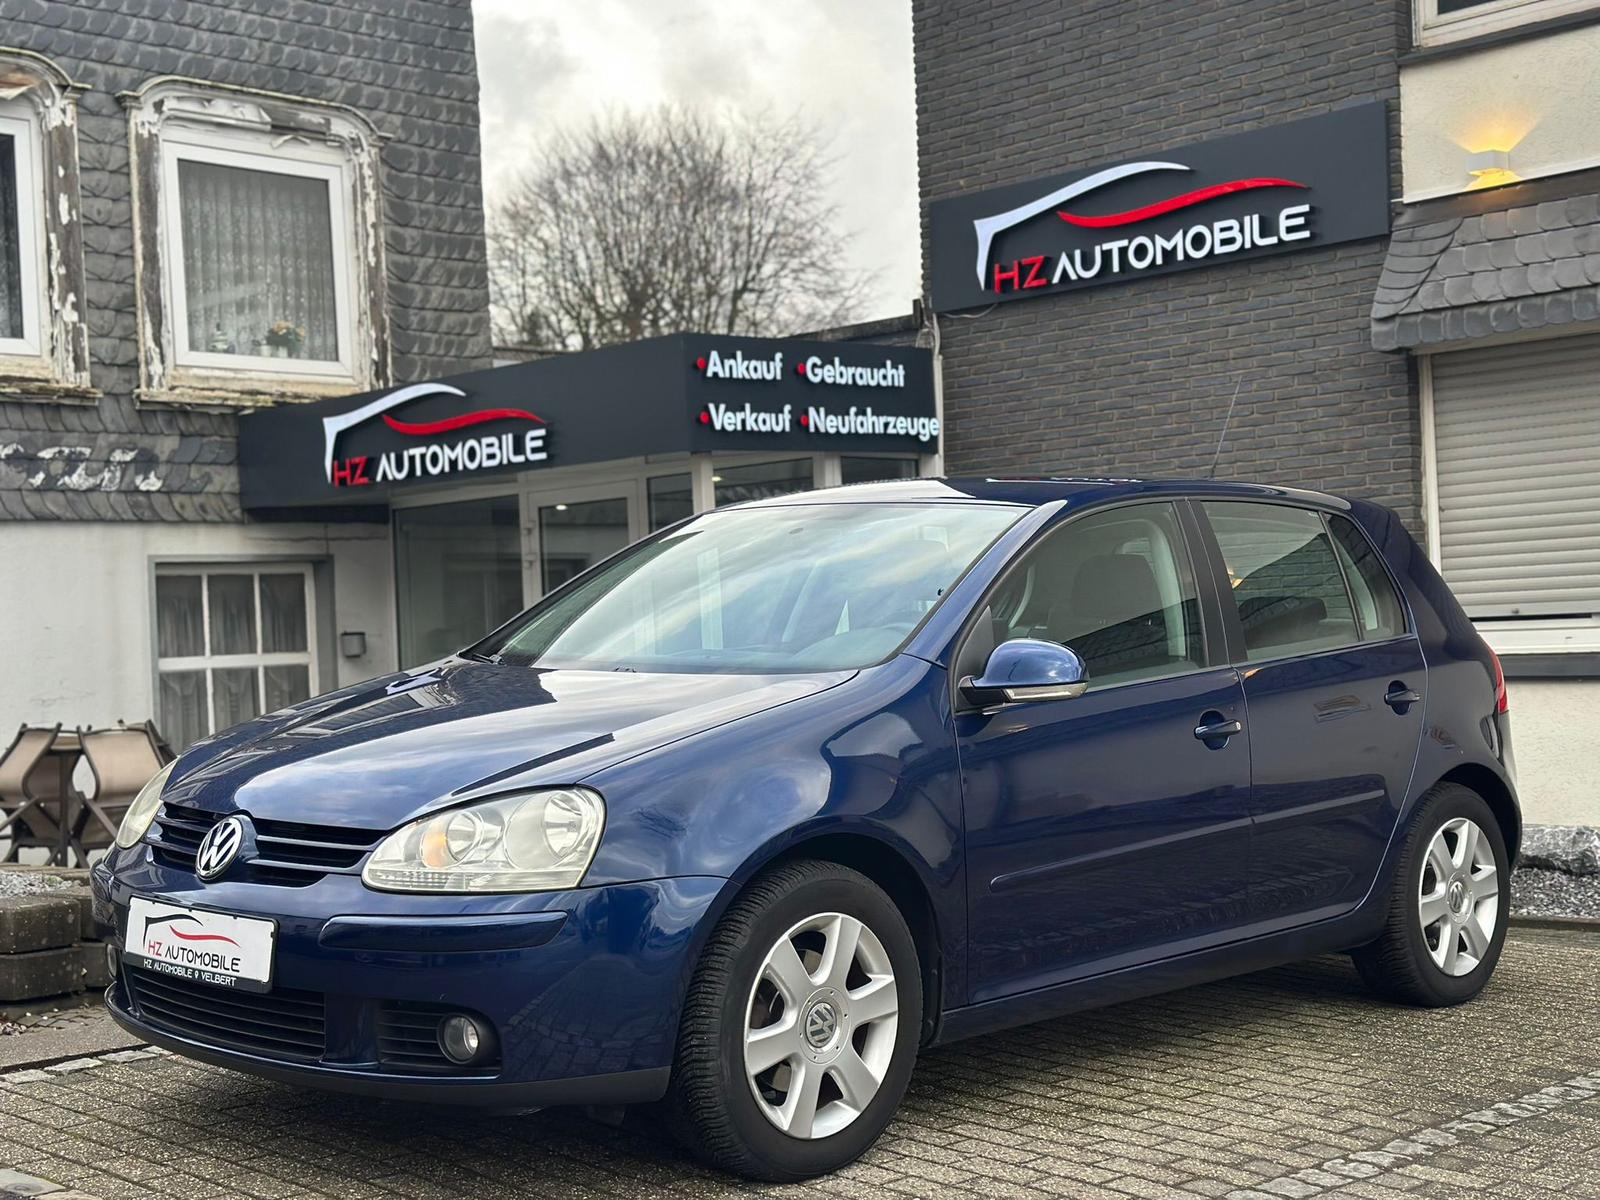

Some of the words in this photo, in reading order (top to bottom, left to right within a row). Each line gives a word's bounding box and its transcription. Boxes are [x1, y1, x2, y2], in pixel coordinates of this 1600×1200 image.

[994, 255, 1048, 294] HZ
[1051, 203, 1311, 284] AUTOMOBILE
[706, 350, 783, 381] Ankauf
[806, 356, 905, 387] Gebraucht
[708, 403, 792, 432] Verkauf
[808, 406, 939, 442] Neufahrzeuge
[333, 456, 370, 488] HZ
[376, 428, 548, 482] AUTOMOBILE
[143, 958, 152, 969] HZ
[153, 962, 193, 979] AUTOMOBILE
[201, 972, 237, 987] VELBERT
[147, 940, 162, 957] HZ
[165, 947, 241, 973] AUTOMOBILE
